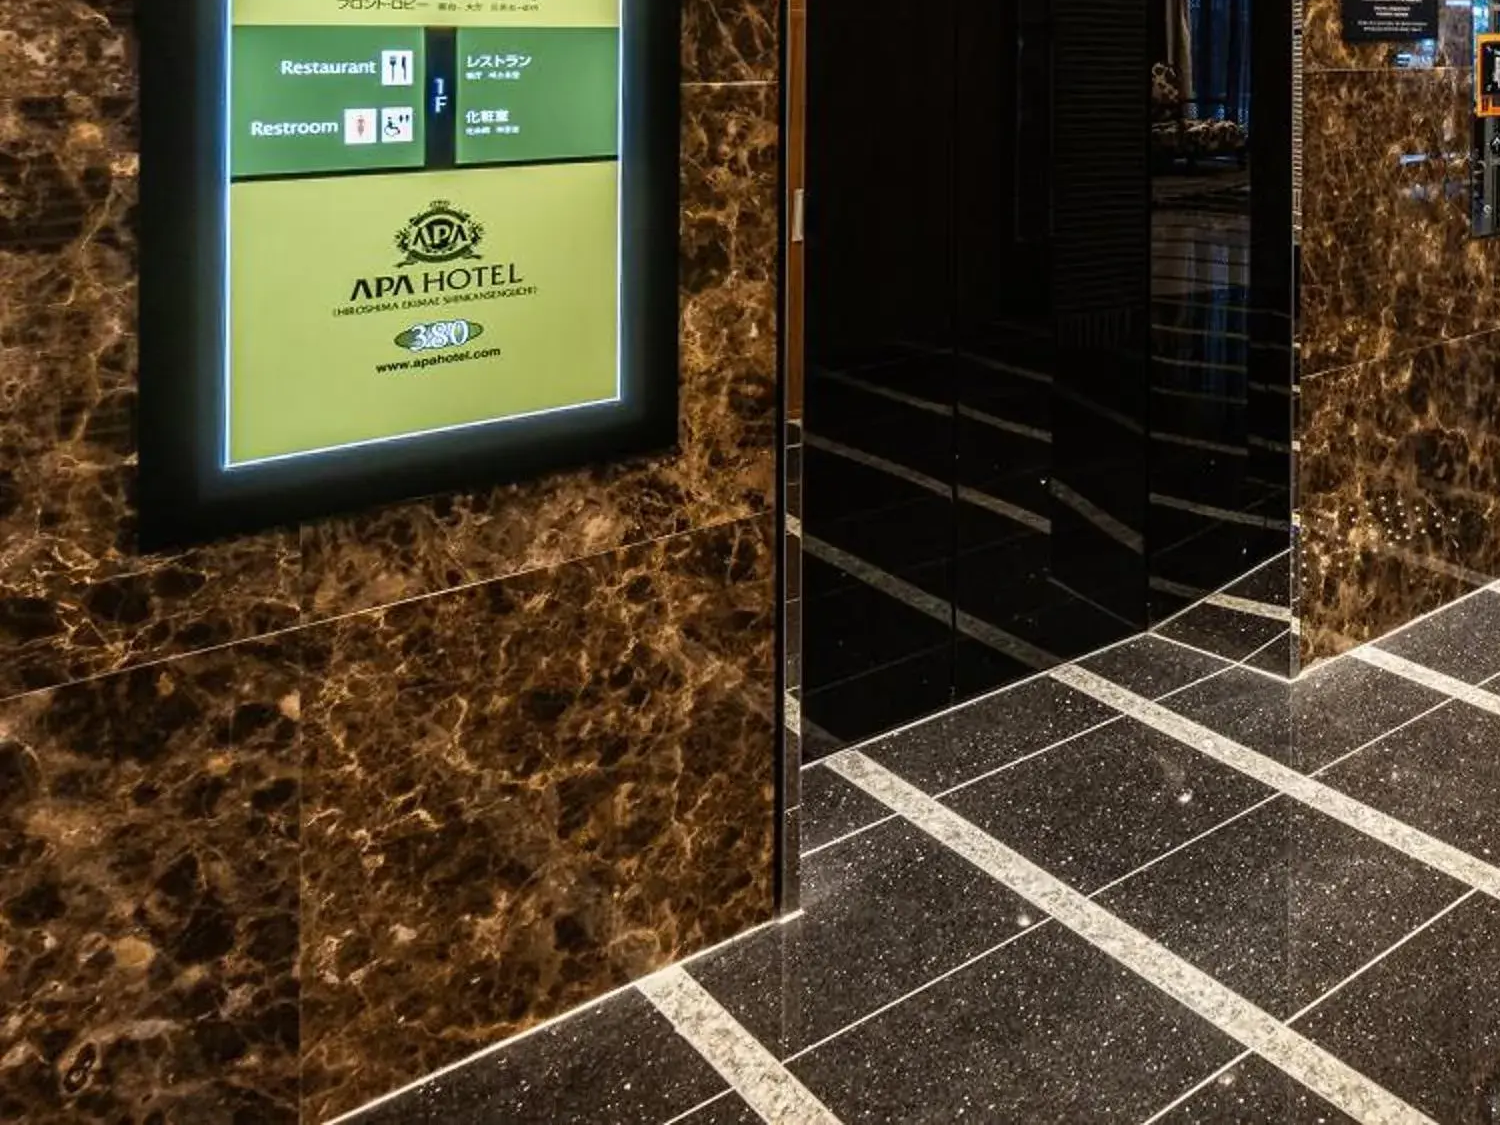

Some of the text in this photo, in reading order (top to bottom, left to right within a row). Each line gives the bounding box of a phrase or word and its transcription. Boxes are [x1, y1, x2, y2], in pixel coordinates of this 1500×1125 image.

[280, 58, 376, 76] Restaurant
[466, 55, 532, 68] レストラン
[250, 117, 339, 136] Restroom
[413, 223, 468, 246] APA
[350, 263, 523, 302] APA HOTEL
[411, 319, 469, 352] 380
[376, 347, 501, 374] www.apahotel.com
